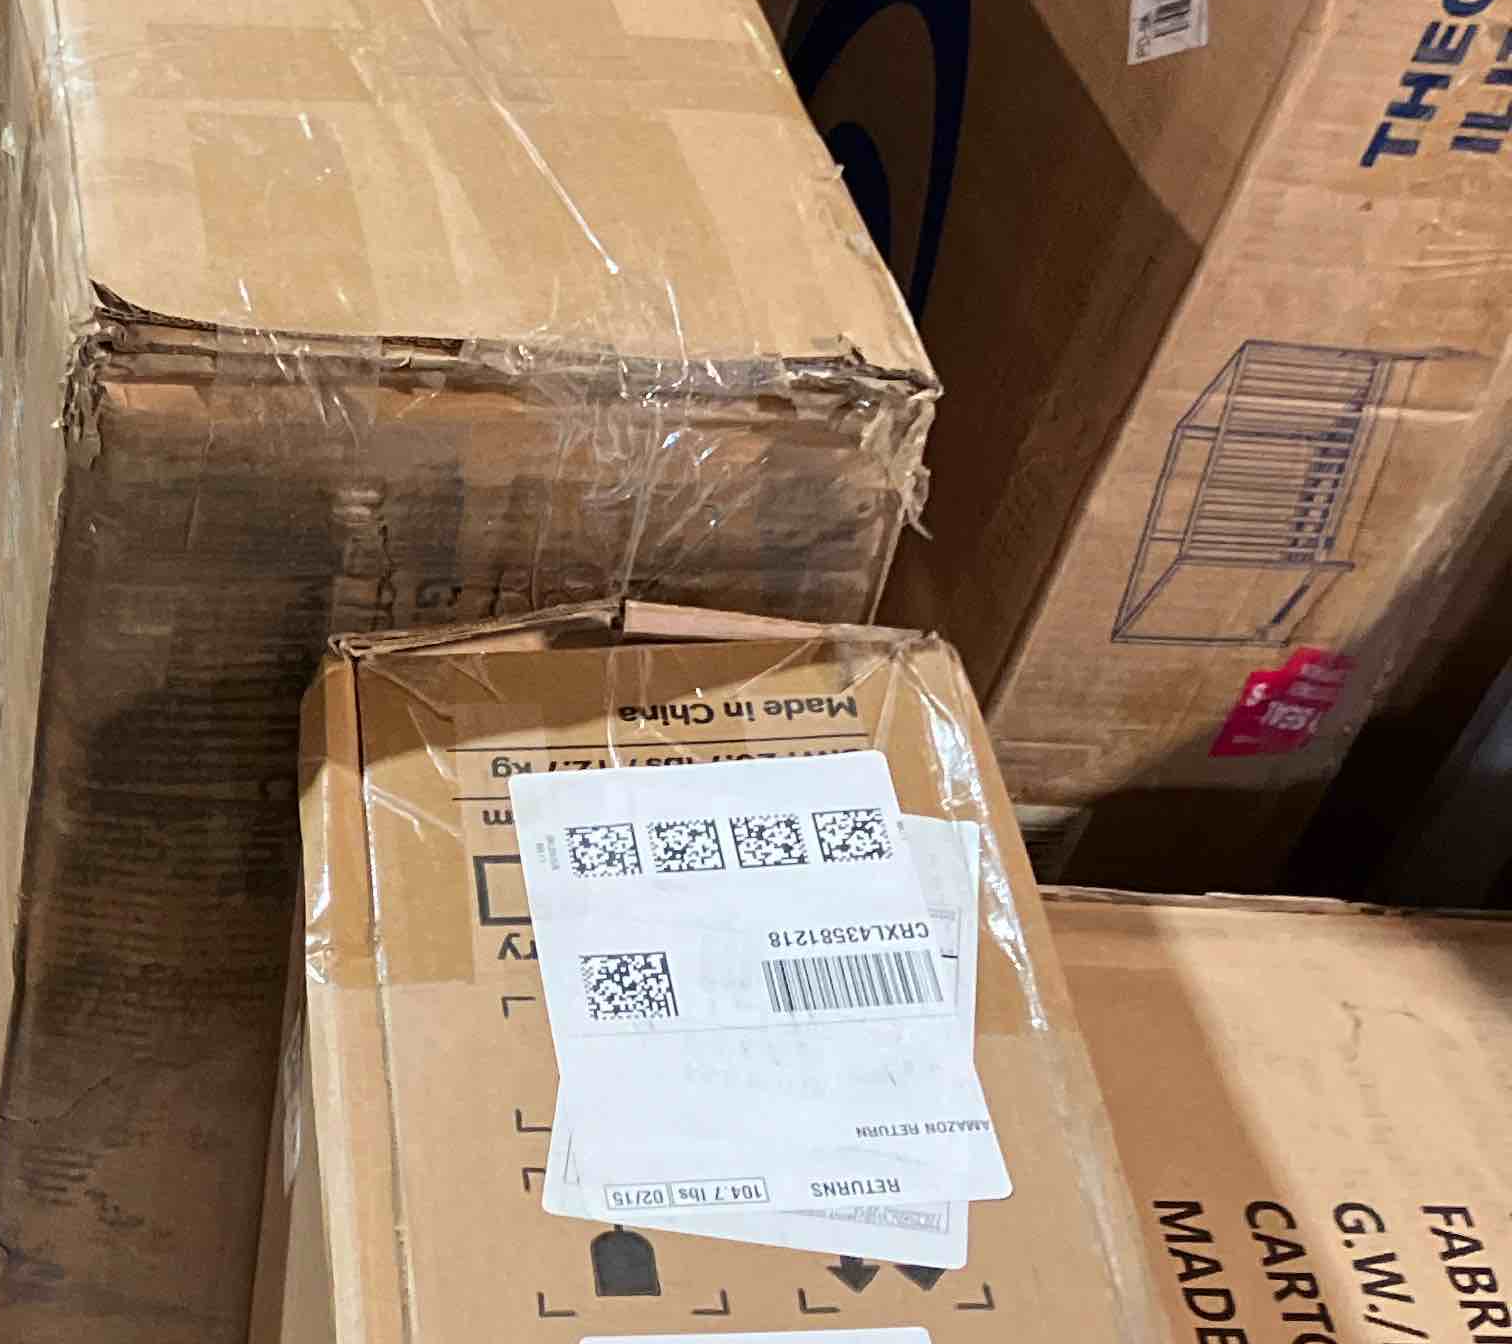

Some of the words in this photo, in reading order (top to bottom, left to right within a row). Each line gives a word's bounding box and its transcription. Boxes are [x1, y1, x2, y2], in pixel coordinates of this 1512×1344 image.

[619, 702, 715, 725] China
[723, 699, 755, 721] in
[764, 696, 858, 720] Made
[768, 922, 930, 948] CRXL43581218
[856, 1122, 920, 1138] RETURN
[925, 1119, 992, 1135] AMAZON
[678, 1187, 706, 1201] lbs
[714, 1183, 762, 1201] 104.7
[811, 1177, 901, 1197] RETURNS
[612, 1188, 665, 1207] 02/15
